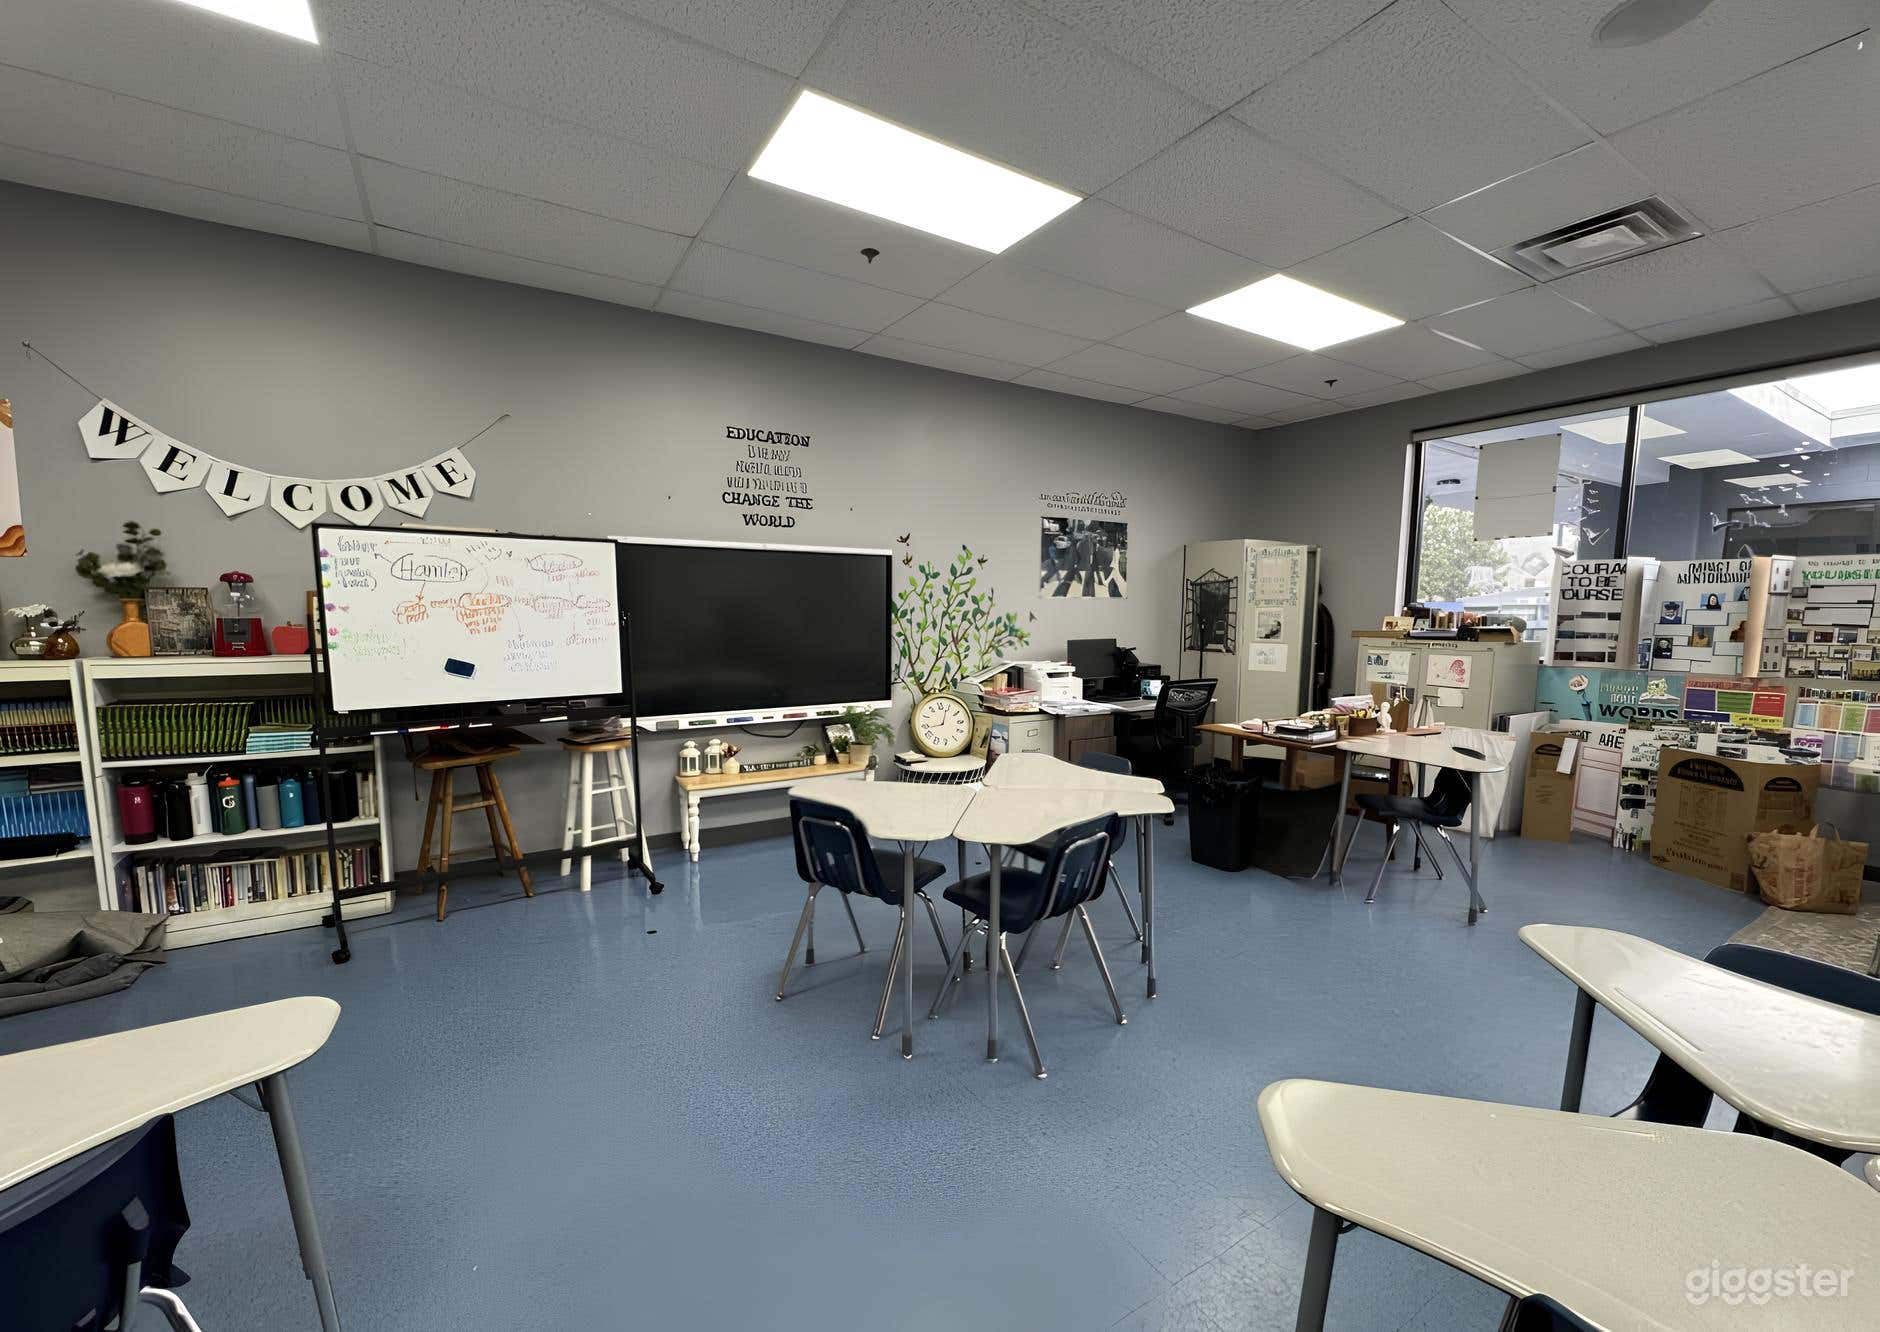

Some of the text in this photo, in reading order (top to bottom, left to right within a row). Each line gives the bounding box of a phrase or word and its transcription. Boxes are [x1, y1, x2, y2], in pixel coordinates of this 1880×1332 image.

[726, 426, 811, 447] EDUCATION
[98, 406, 469, 512] WELCOME
[722, 492, 814, 510] CHANGE THE
[742, 513, 796, 528] WORLD
[1567, 576, 1592, 588] TO
[1598, 733, 1625, 750] ARE
